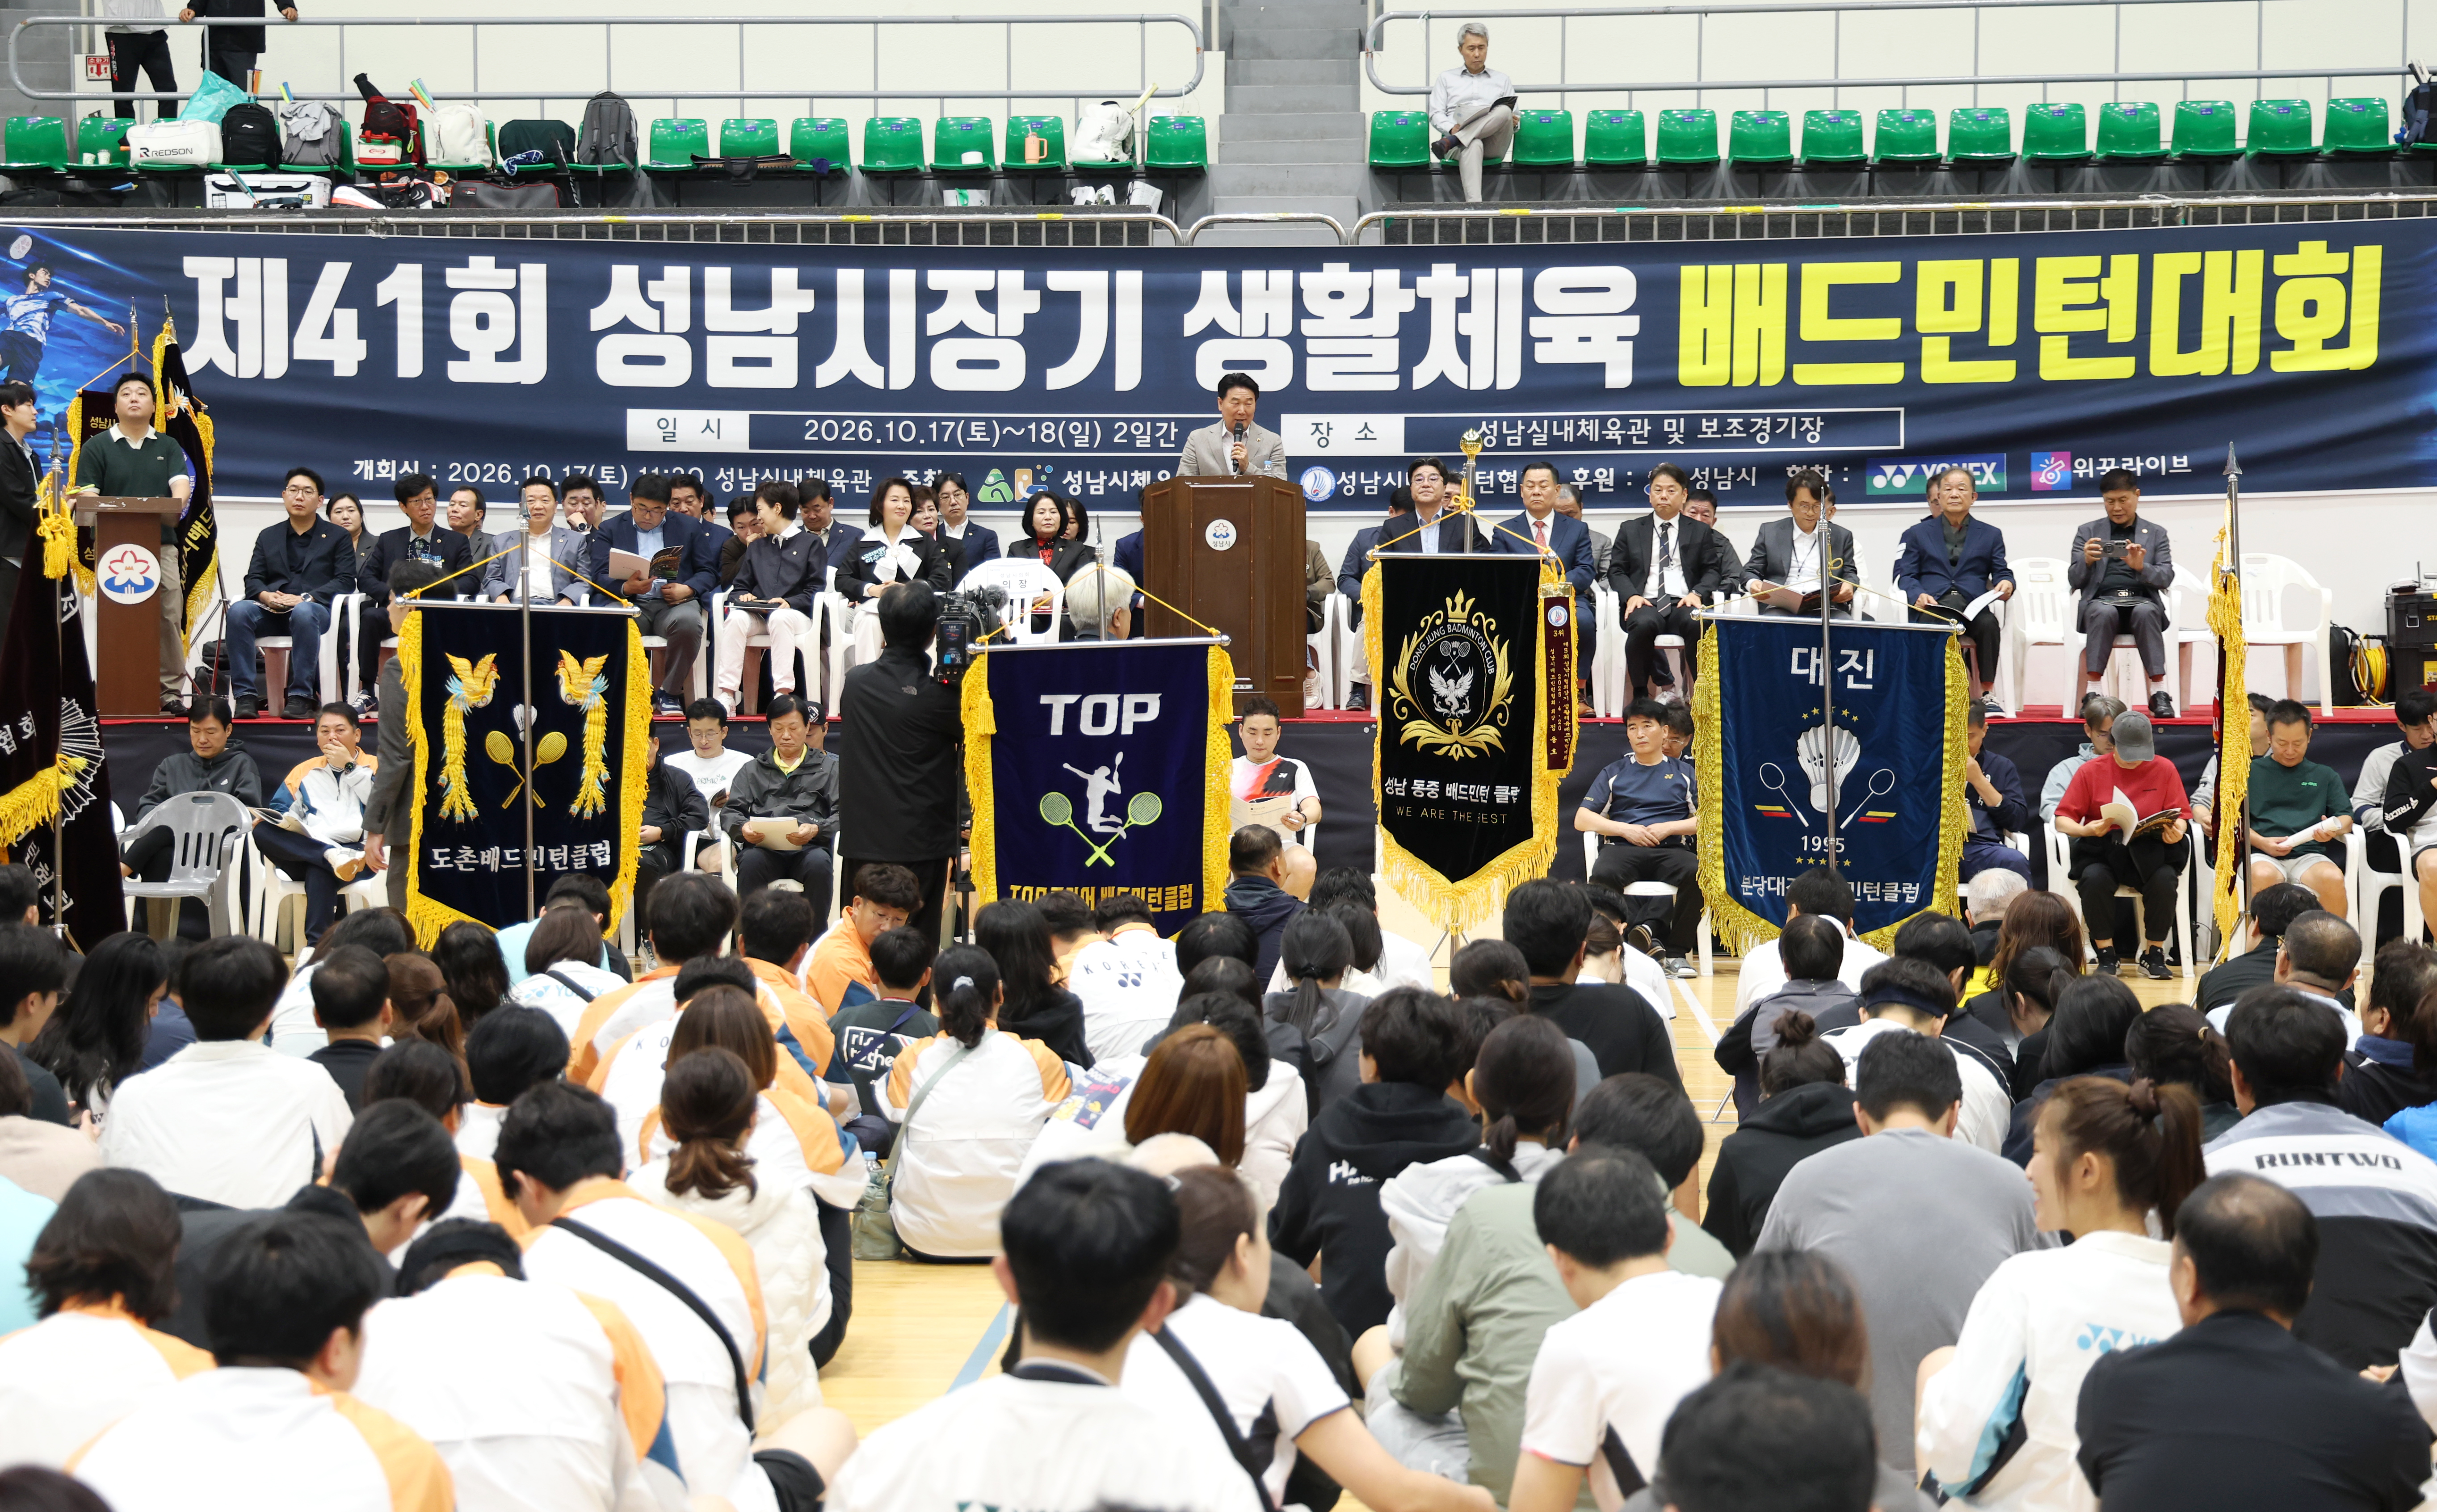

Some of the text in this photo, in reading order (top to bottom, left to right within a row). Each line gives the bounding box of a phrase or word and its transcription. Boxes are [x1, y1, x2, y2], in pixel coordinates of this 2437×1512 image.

[151, 148, 193, 157] REDSON
[181, 240, 2383, 392] 제41회 성남시장기 생활체육 배드민턴대회
[1113, 420, 1179, 448] 2일간
[1478, 416, 1824, 447] 성남실내체육관 및 보조경기장
[1570, 467, 1614, 492] 후원
[1689, 466, 1756, 491] 성남시
[1553, 629, 1564, 638] 3위
[1409, 623, 1495, 675] DONG JUNG BADMINTON CLUB
[1790, 646, 1874, 690] 대진
[1039, 693, 1163, 736] TOP
[1385, 777, 1407, 796] 성남
[1411, 779, 1440, 798] 동중
[1445, 782, 1489, 803] 배드민턴
[1396, 806, 1412, 816] WE
[1421, 808, 1445, 819] ARE
[1452, 810, 1472, 823] THE
[2255, 1151, 2402, 1171] RUNTWO
